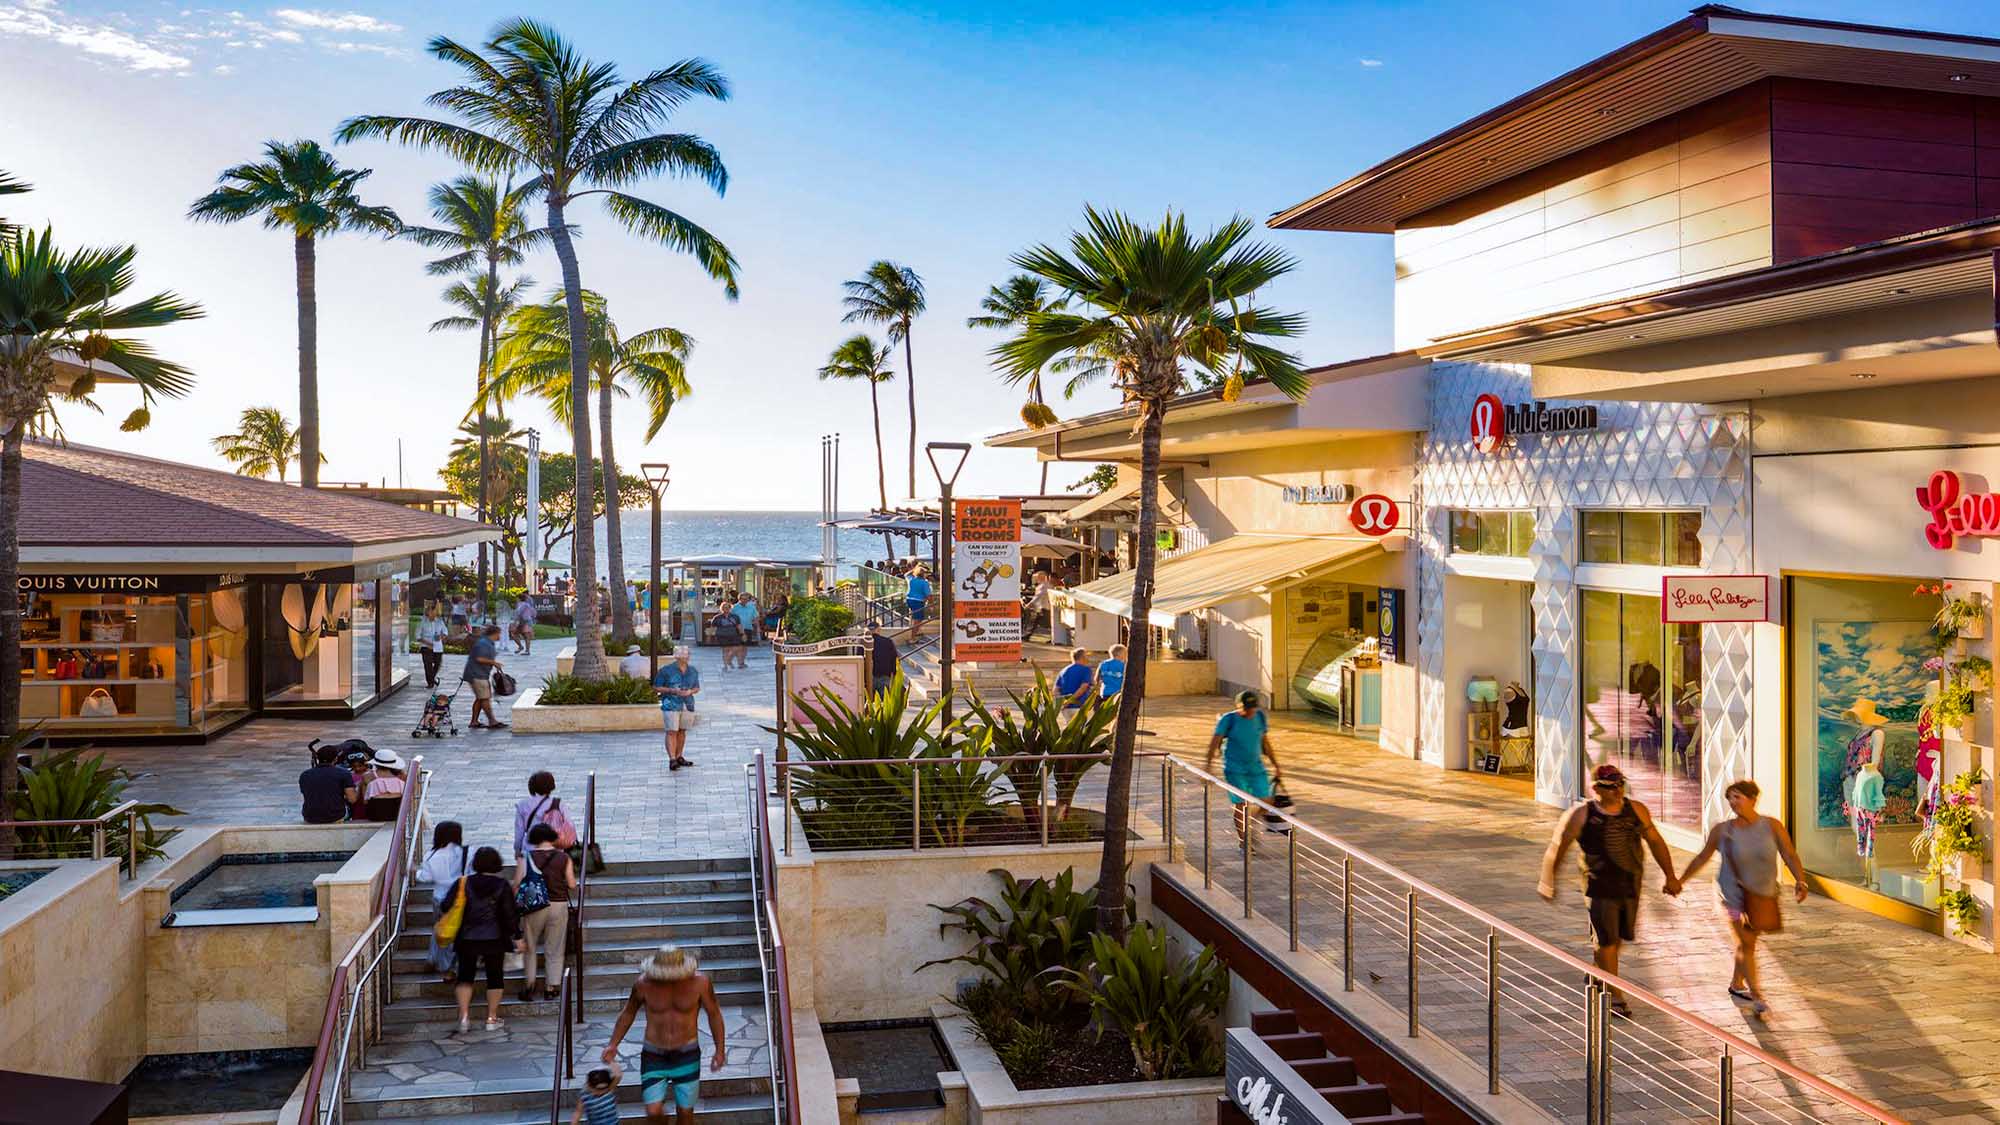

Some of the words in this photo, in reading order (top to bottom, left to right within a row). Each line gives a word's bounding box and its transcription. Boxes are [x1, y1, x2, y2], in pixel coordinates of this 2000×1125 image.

[1504, 402, 1596, 434] lululemon
[968, 505, 1008, 516] MAUI
[1916, 470, 2000, 549] Lill
[962, 518, 1015, 528] ESCAPE
[962, 530, 1015, 540] ROOMS
[18, 577, 66, 589] OUIS
[74, 577, 159, 589] VUITTON
[1671, 588, 1714, 612] Lilly
[1710, 587, 1764, 608] Pulitzer
[782, 644, 818, 654] WHALERS
